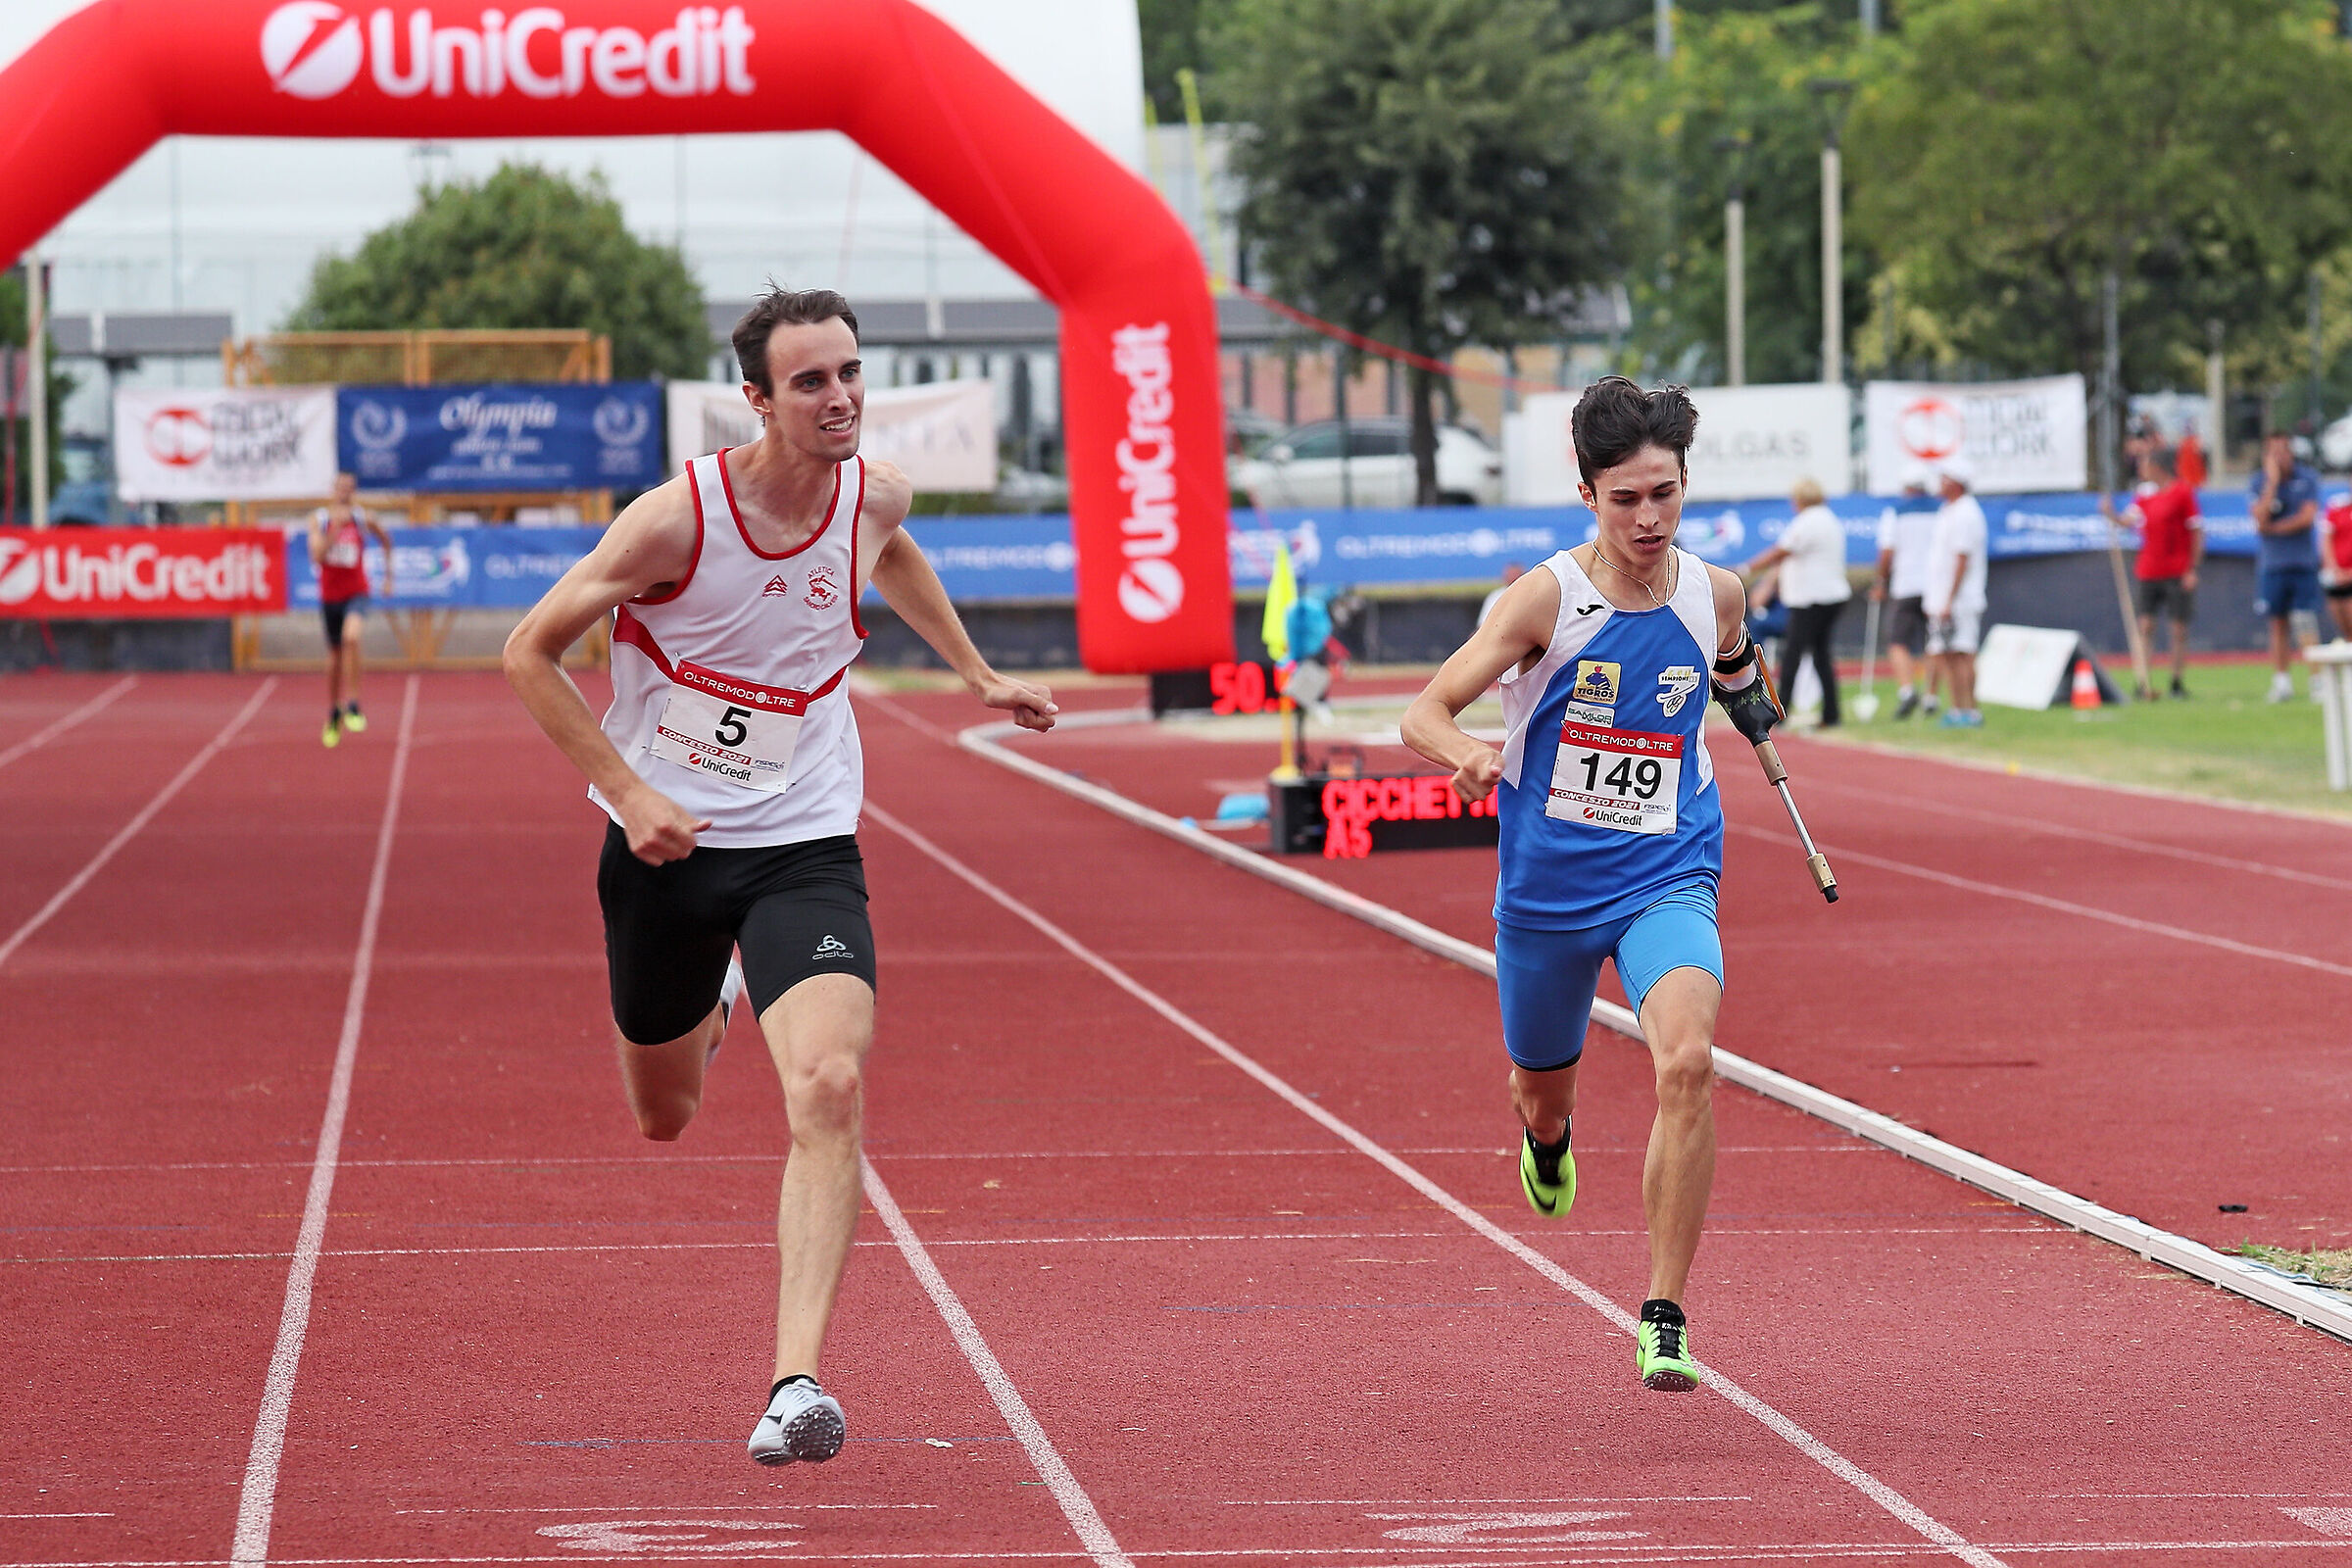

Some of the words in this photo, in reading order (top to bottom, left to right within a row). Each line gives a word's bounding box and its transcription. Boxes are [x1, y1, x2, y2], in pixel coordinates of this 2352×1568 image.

[368, 7, 756, 98] UniCredit
[440, 392, 558, 441] Olympia
[1111, 321, 1180, 559] UniCredit
[44, 542, 271, 602] UniCredit
[808, 565, 835, 579] ATLETICA
[684, 671, 796, 708] OLTREMODOLTRE
[1578, 687, 1615, 699] TIGROS
[714, 705, 753, 748] 5
[1569, 729, 1674, 752] OLTREMODOLTRE
[662, 728, 719, 756] CONCESIO
[720, 750, 751, 764] 2021
[702, 757, 752, 782] UniCredit
[1580, 752, 1662, 800] 149
[1554, 789, 1610, 807] CONCESIO
[1611, 801, 1640, 810] 2021
[1595, 809, 1642, 826] UniCredit
[1323, 817, 1373, 860] A5
[811, 951, 855, 960] odlo
